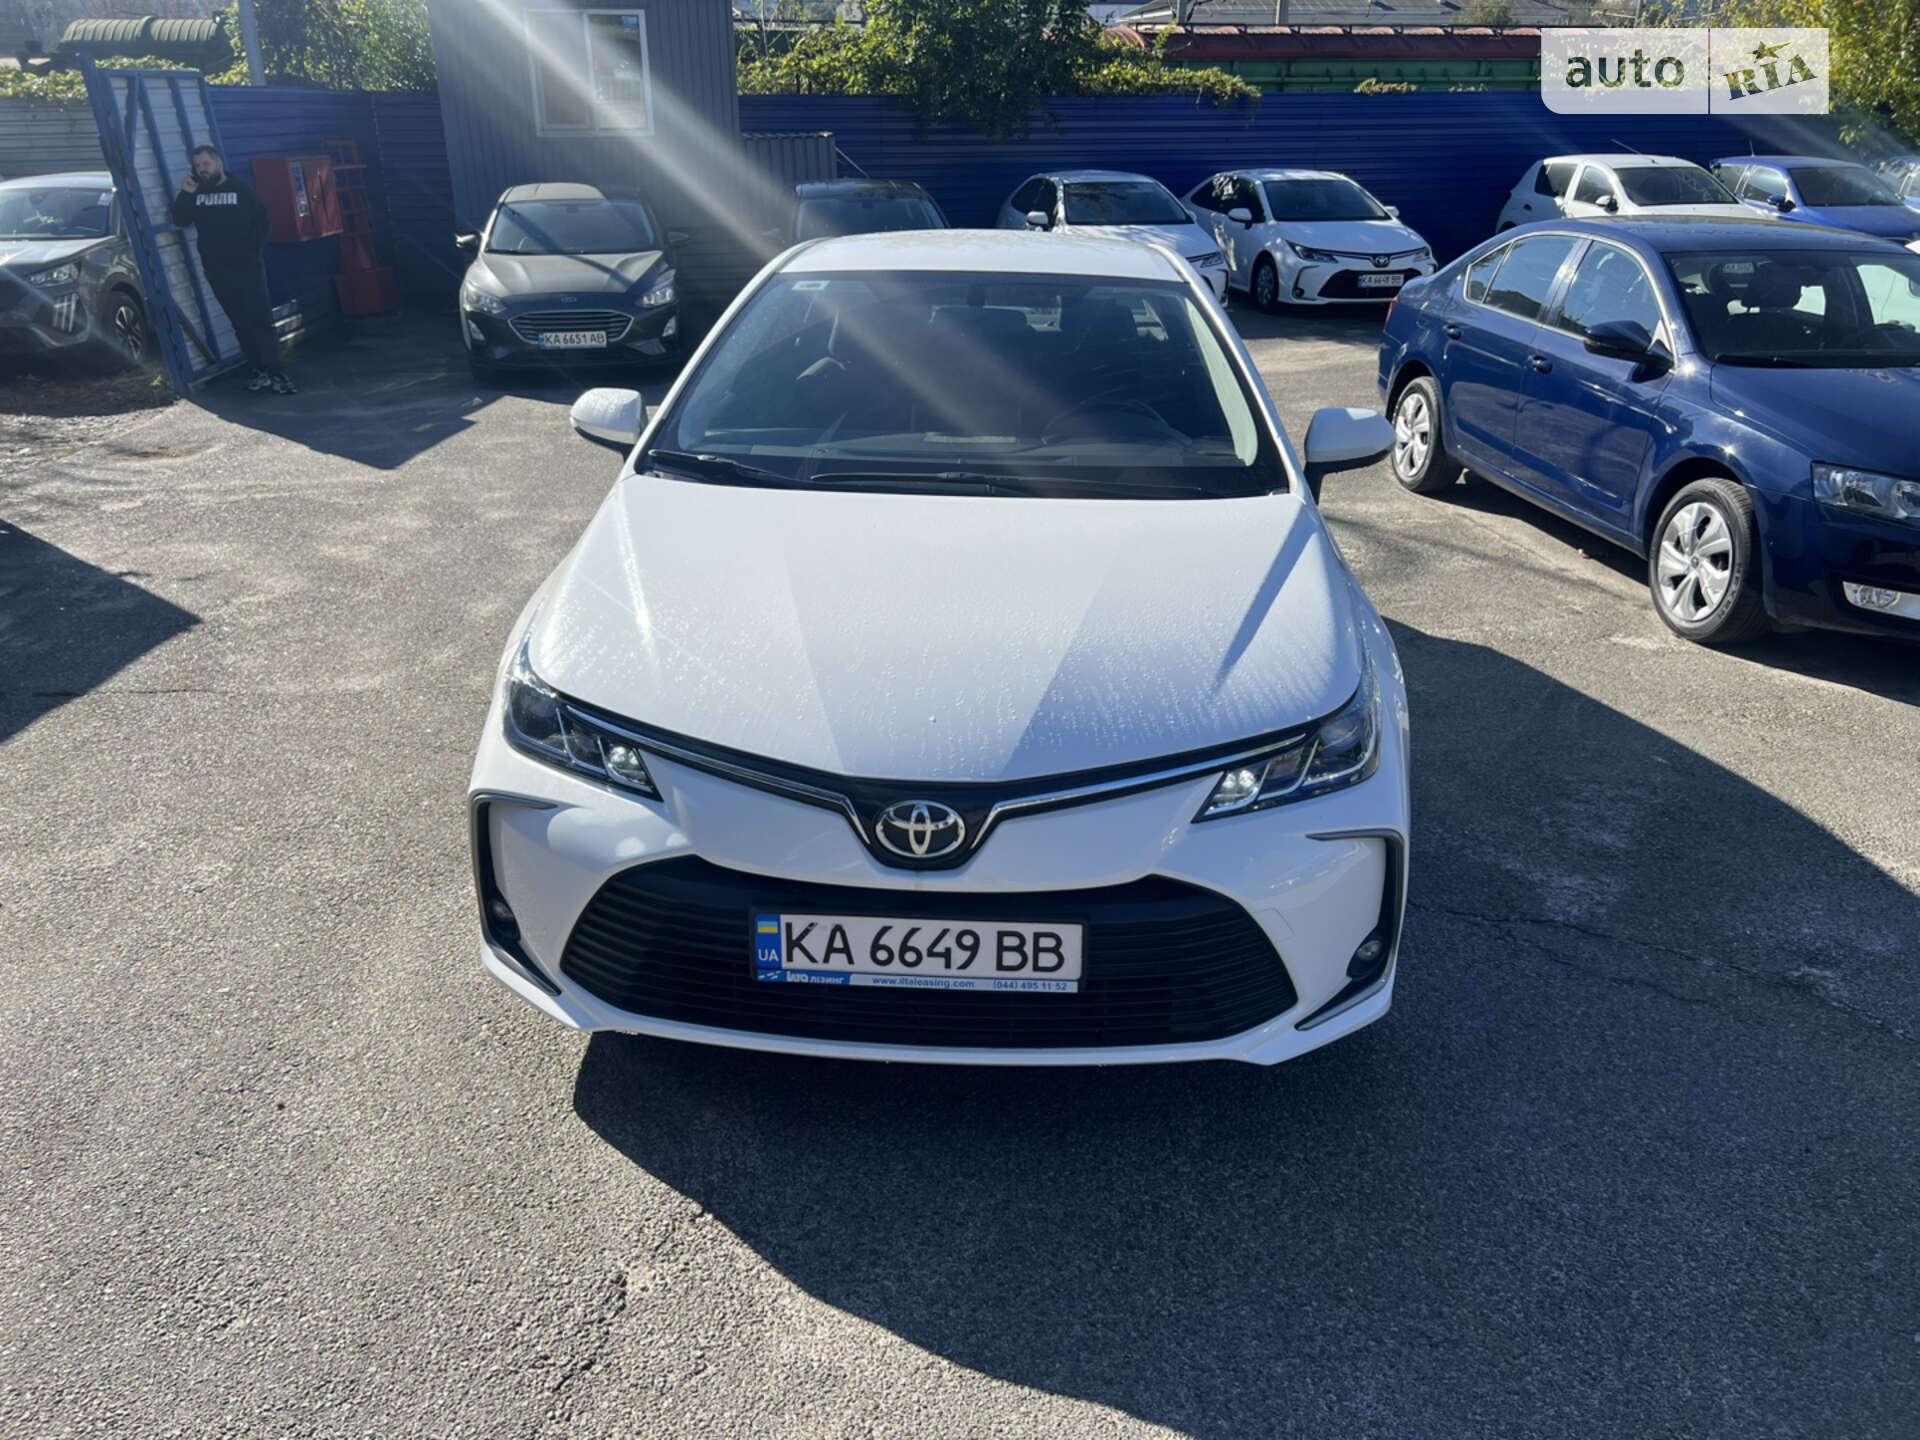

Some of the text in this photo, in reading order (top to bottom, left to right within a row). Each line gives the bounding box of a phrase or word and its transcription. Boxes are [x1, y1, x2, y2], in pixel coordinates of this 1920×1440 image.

[195, 191, 238, 206] PUMA
[544, 333, 605, 345] KA 6651 AB
[785, 922, 1065, 972] KA 6649 BB
[758, 948, 779, 962] UA
[871, 976, 1068, 992] www.iltaleasing.com (044) 495 11 52
